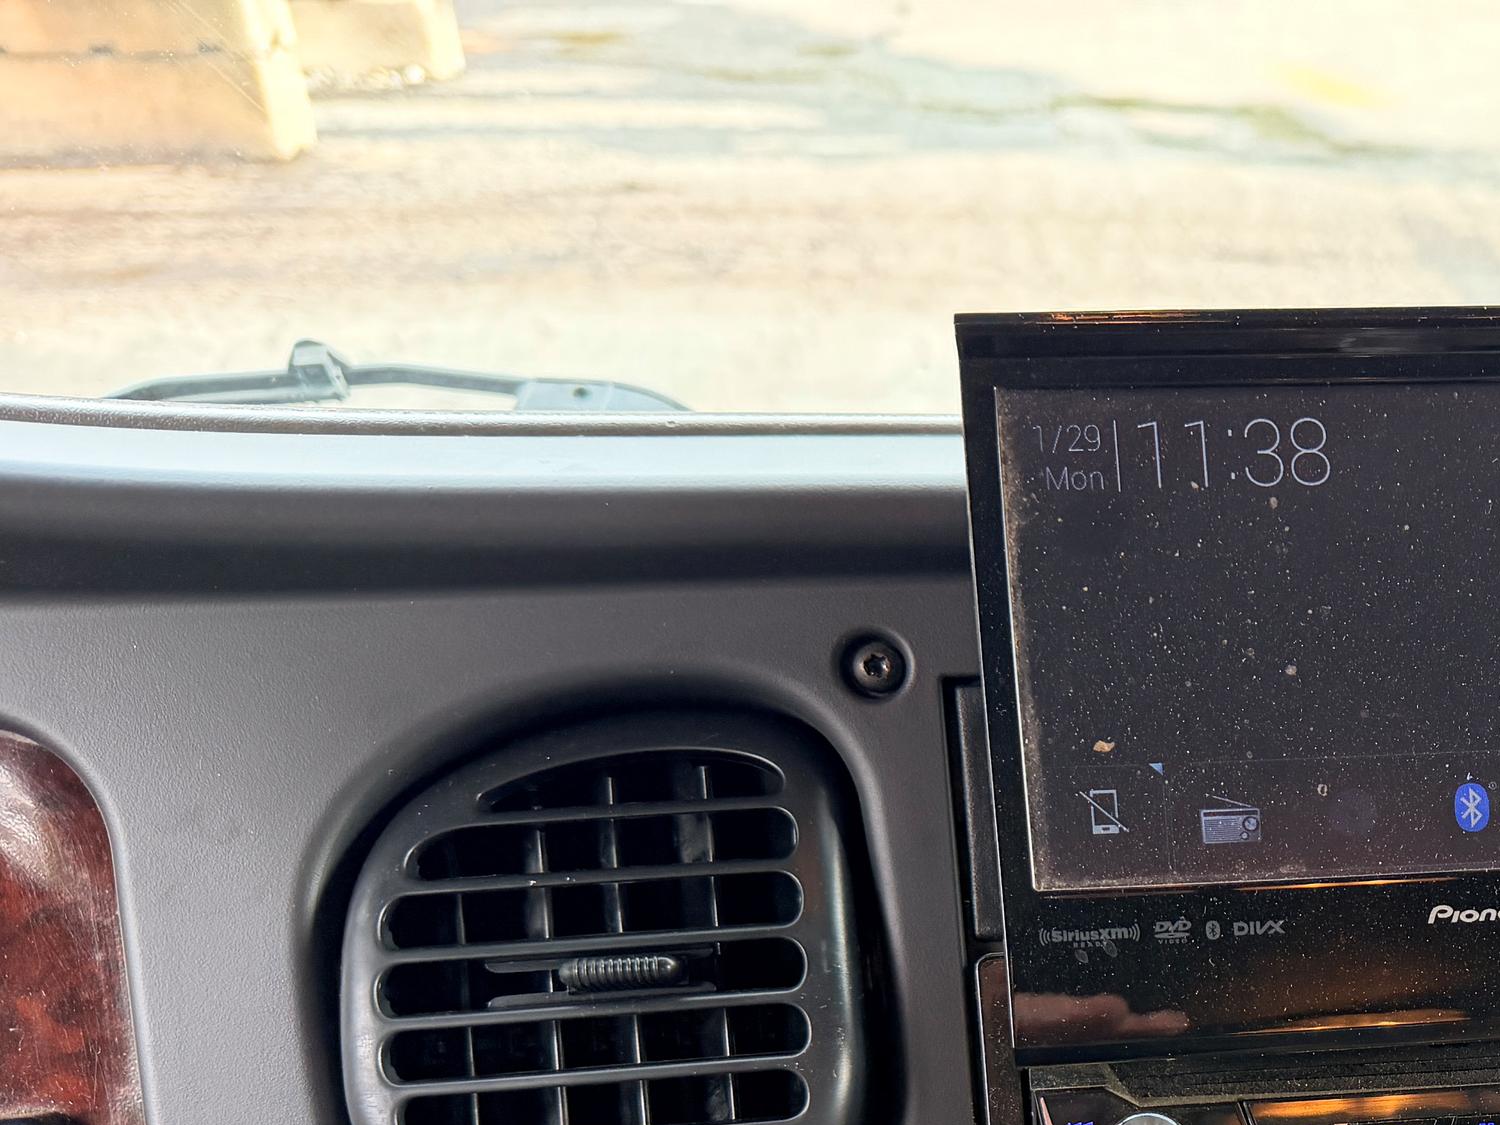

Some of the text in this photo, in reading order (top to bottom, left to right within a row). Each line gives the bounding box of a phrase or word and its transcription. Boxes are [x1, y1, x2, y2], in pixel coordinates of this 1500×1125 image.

[1033, 424, 1101, 454] 1/29
[1137, 417, 1332, 489] 11:38
[1045, 465, 1105, 491] Mon
